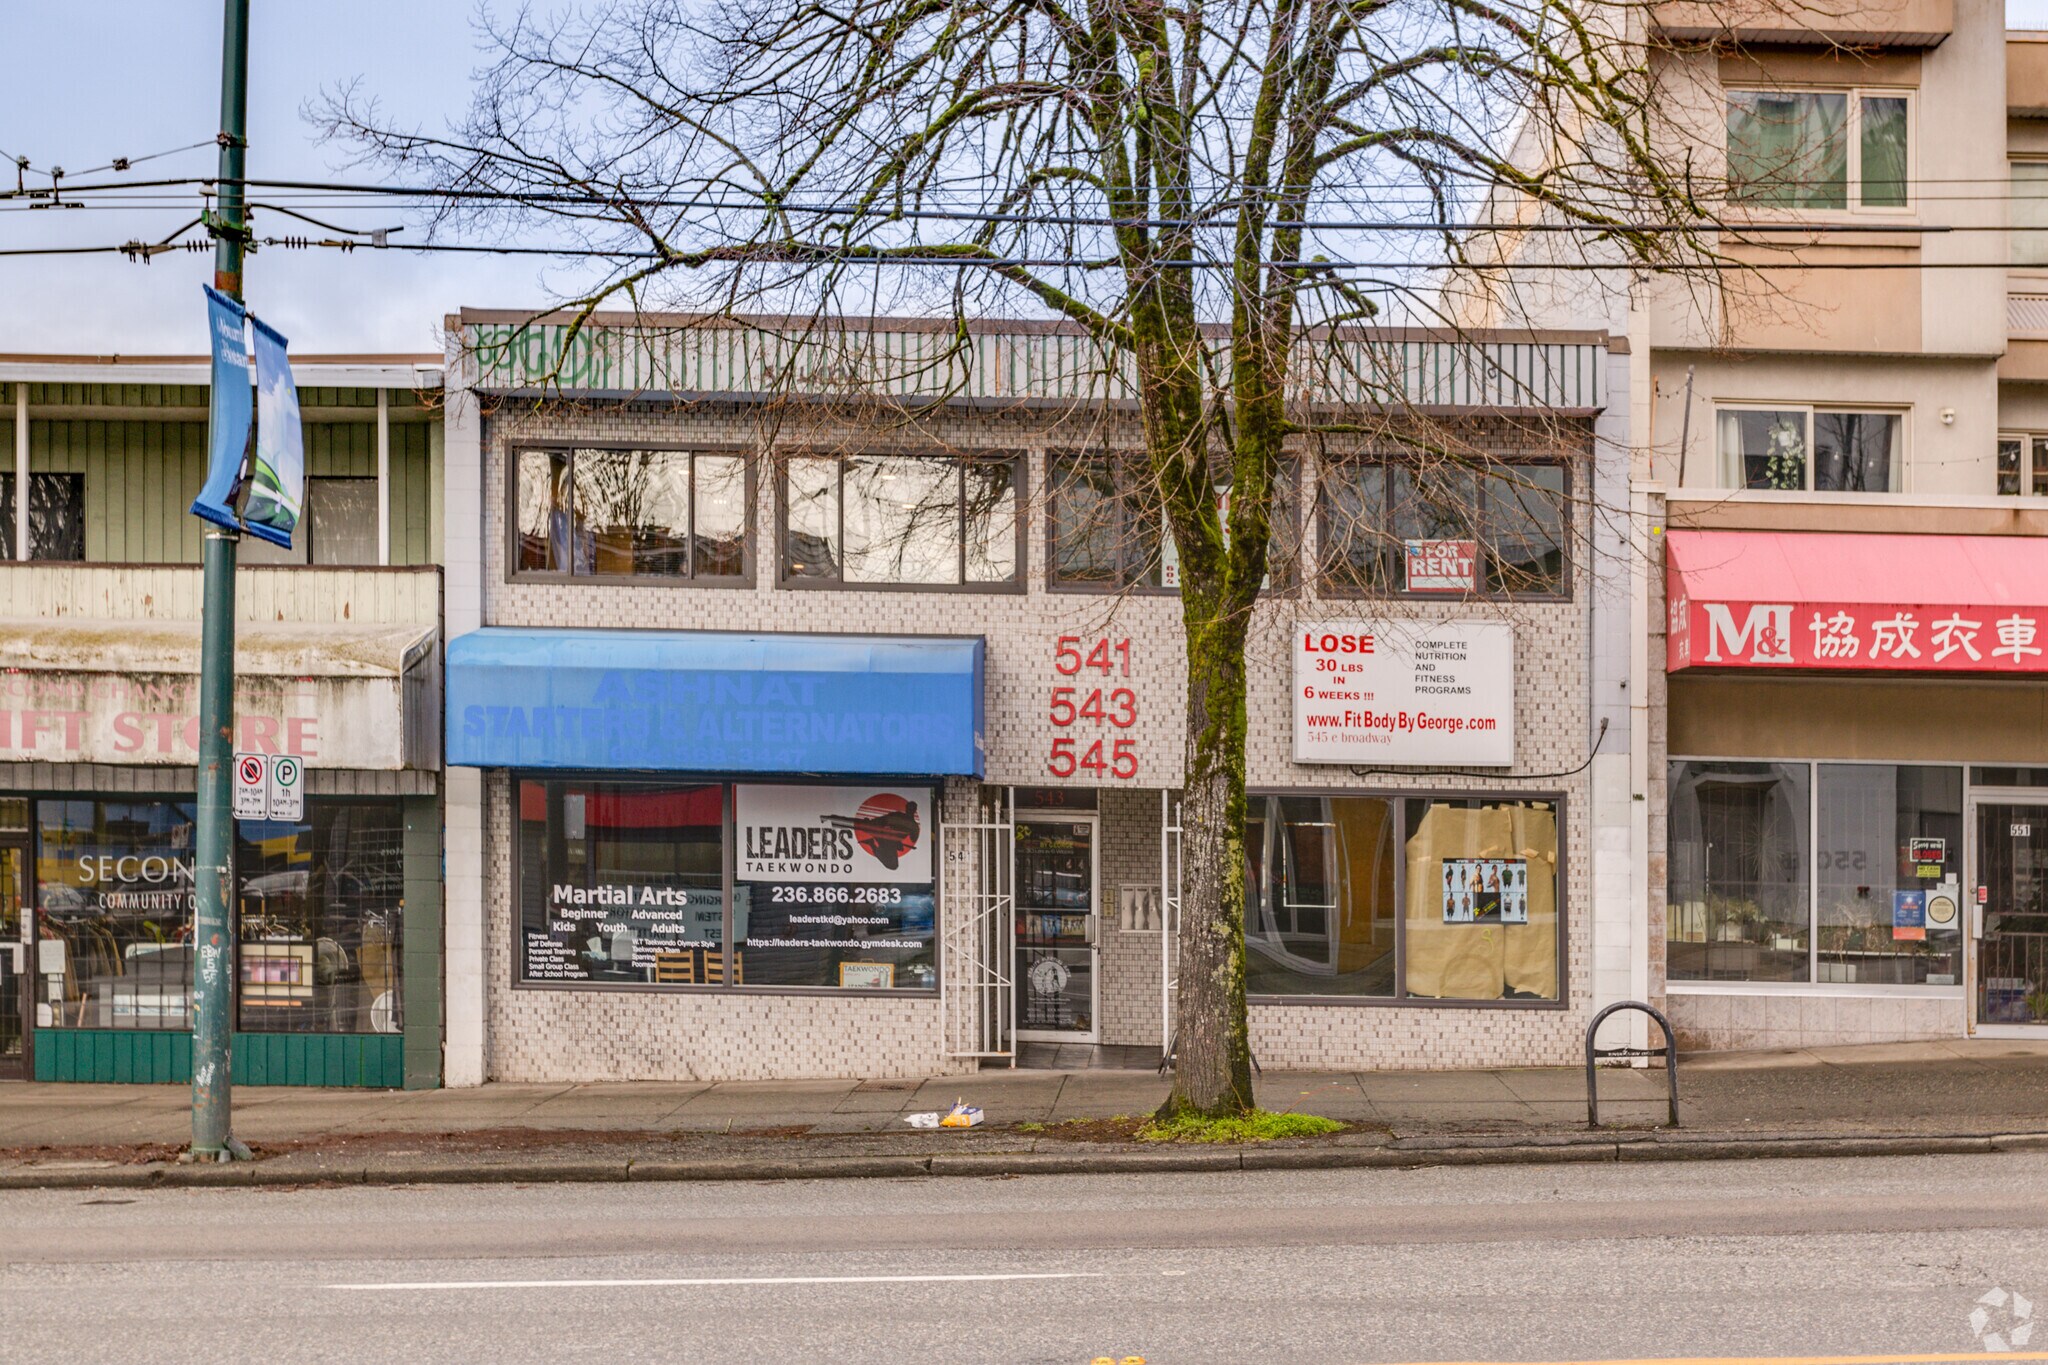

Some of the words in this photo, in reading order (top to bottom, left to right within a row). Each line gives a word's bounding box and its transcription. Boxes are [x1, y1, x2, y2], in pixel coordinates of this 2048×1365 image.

[1425, 545, 1459, 558] FOR
[1411, 557, 1473, 576] RENT
[1304, 633, 1375, 654] LOSE
[1808, 610, 2043, 665] 協成衣車
[1415, 640, 1468, 650] COMPLETE
[1056, 636, 1130, 677] 541
[1415, 652, 1467, 661] NUTRITION
[1315, 658, 1337, 672] 30
[1341, 663, 1364, 673] LBS
[1415, 663, 1436, 672] AND
[1333, 676, 1345, 685] IN
[1415, 675, 1456, 683] FITNESS
[0, 678, 85, 699] COND
[92, 682, 198, 703] CHANCE
[592, 671, 827, 706] ASHNAT
[1304, 685, 1315, 699] 6
[1318, 691, 1361, 701] WEEKS
[1415, 686, 1472, 695] PROGRAMS
[1050, 687, 1137, 728] 543
[463, 704, 651, 740] STARTERS
[659, 710, 684, 742] &
[696, 710, 959, 745] ALTERNATORS
[1307, 731, 1328, 743] 545
[1341, 732, 1393, 746] broadway
[1050, 738, 1139, 779] 545
[281, 788, 291, 798] 1h
[2011, 825, 2029, 836] 551
[746, 826, 854, 861] LEADERS
[1913, 849, 1942, 859] CLOSED
[79, 855, 195, 883] SECON
[745, 861, 853, 874] TAEKWONDO
[99, 893, 182, 909] COMMUNITY
[553, 884, 633, 905] Martial
[640, 886, 688, 906] Arts
[771, 886, 902, 904] 236.866.2683
[560, 908, 609, 920] Beginner
[631, 909, 683, 920] Advanced
[789, 914, 889, 926] leaderstkd@yahoo.com
[553, 921, 577, 932] Kids
[596, 921, 628, 933] Youth
[651, 923, 685, 934] Adults
[540, 940, 563, 948] Defense
[632, 945, 664, 953] Taekwondo
[677, 940, 700, 948] Olympic
[747, 938, 922, 949] https://leaders-taekwondo.gymdesk.com
[554, 948, 576, 956] Training
[632, 954, 656, 962] Sparring
[545, 963, 563, 971] Group
[632, 961, 658, 969] Poomsae
[844, 965, 890, 973] TAEKWONDO
[528, 970, 544, 978] After
[544, 970, 563, 978] School
[564, 971, 588, 979] Program
